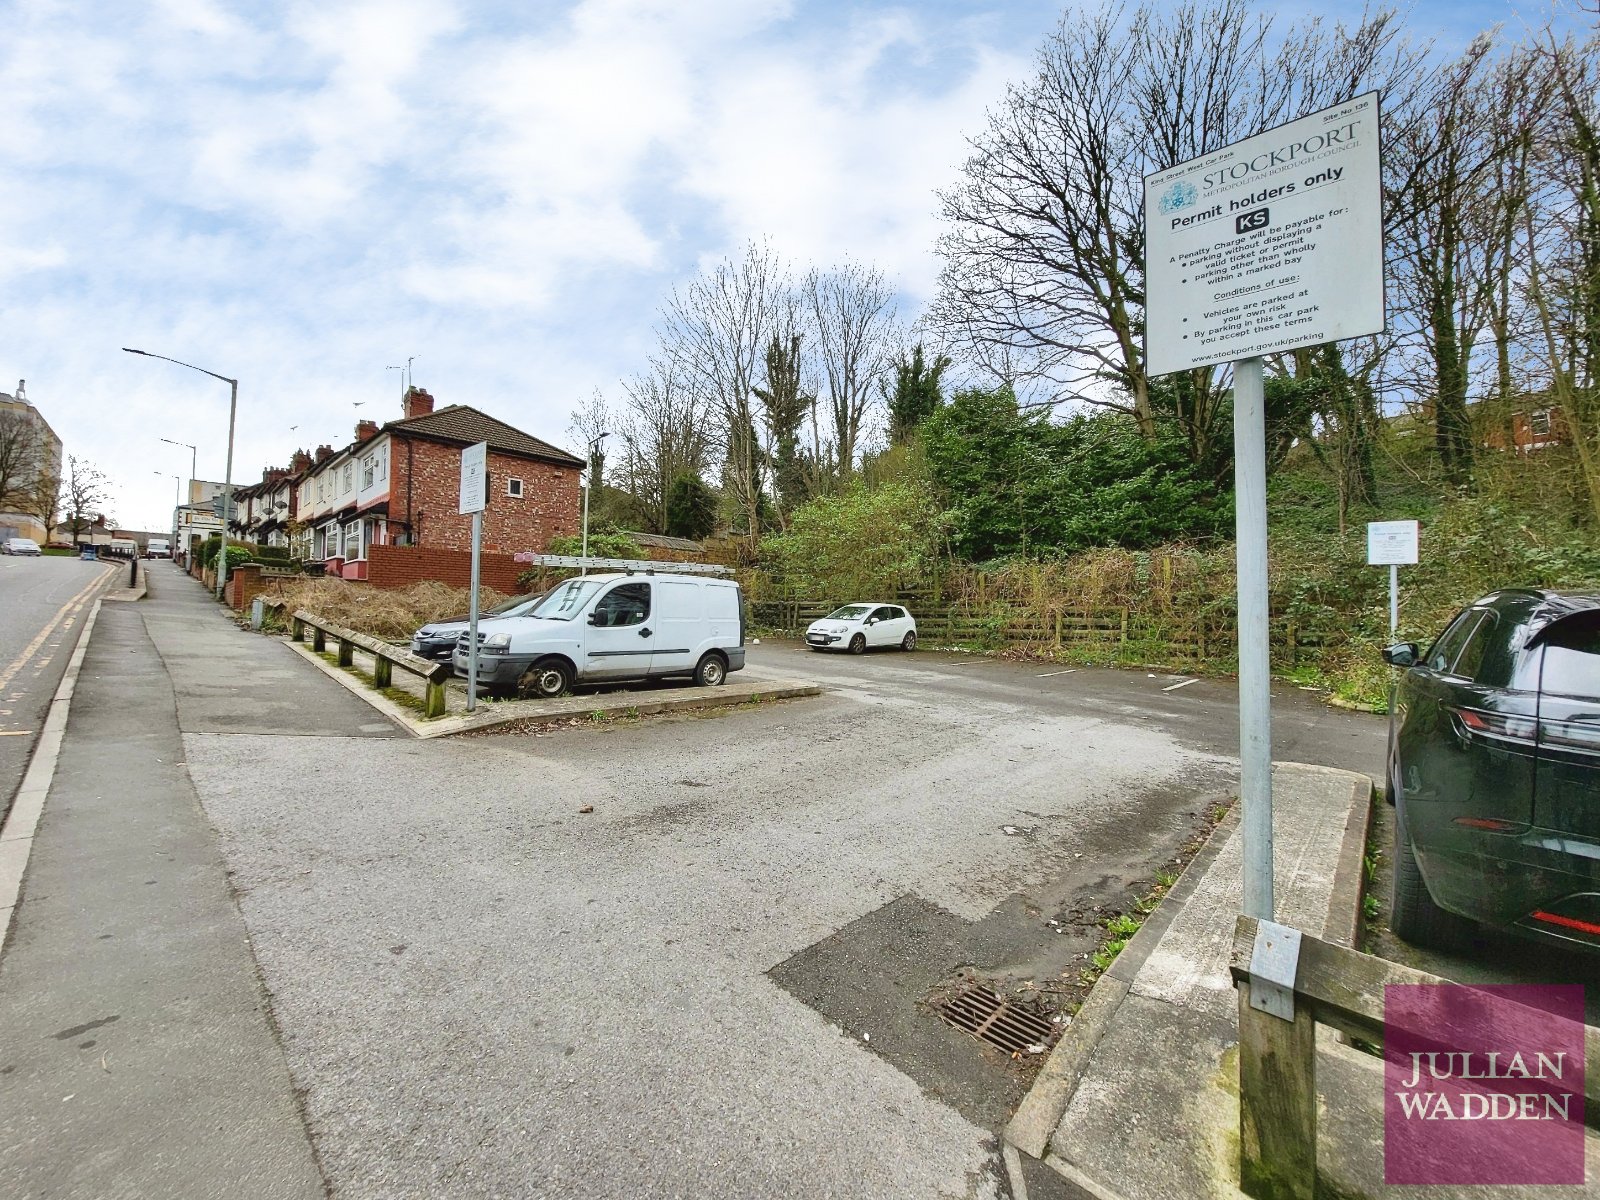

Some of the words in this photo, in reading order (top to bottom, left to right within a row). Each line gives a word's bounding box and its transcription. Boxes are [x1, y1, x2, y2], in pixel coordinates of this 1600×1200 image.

[1323, 112, 1338, 122] Site
[1341, 108, 1352, 116] No
[1355, 102, 1369, 111] 136
[1150, 177, 1163, 186] King
[1166, 170, 1184, 179] Street
[1188, 163, 1203, 172] West
[1205, 158, 1216, 166] Car
[1219, 152, 1234, 160] Park
[1203, 120, 1361, 190] STOCKPORT
[1203, 172, 1267, 198] METROPOLITAN
[1269, 155, 1315, 176] BOROUGH
[1317, 140, 1362, 160] COUNCIL
[1171, 204, 1222, 230] Permit
[1230, 182, 1296, 211] holders
[1304, 166, 1344, 187] only
[1179, 247, 1210, 260] Penalty
[1214, 237, 1246, 250] Charge
[1249, 229, 1266, 240] will
[1270, 226, 1282, 234] be
[1285, 214, 1324, 231] payable
[1240, 211, 1266, 230] KS
[1190, 252, 1222, 266] parking
[1225, 240, 1260, 256] without
[1264, 226, 1312, 245] displaying
[1195, 267, 1227, 281] parking
[1230, 260, 1254, 271] other
[1258, 253, 1280, 263] than
[1284, 243, 1316, 256] wholly
[1205, 258, 1227, 269] valid
[1229, 250, 1256, 263] ticket
[1259, 247, 1269, 255] or
[1272, 236, 1304, 252] permit
[1207, 274, 1234, 285] within
[1246, 260, 1281, 275] marked
[1284, 256, 1302, 265] bay
[1203, 306, 1240, 319] Vehicles
[1243, 302, 1258, 310] are
[1261, 292, 1295, 307] parked
[1298, 289, 1309, 297] at
[1213, 284, 1261, 300] Conditions
[1265, 279, 1275, 288] of
[1278, 275, 1300, 284] use:
[1194, 330, 1205, 338] By
[1208, 322, 1242, 336] parking
[1244, 319, 1253, 327] in
[1256, 315, 1274, 324] this
[1277, 311, 1293, 320] car
[1297, 305, 1320, 317] park
[1223, 314, 1242, 325] your
[1246, 310, 1266, 318] own
[1269, 303, 1286, 313] risk
[1191, 332, 1324, 363] www.stockport.gov.uk/parking
[1200, 336, 1216, 346] you
[1219, 328, 1250, 341] accept
[1254, 323, 1281, 334] these
[1284, 316, 1313, 327] terms
